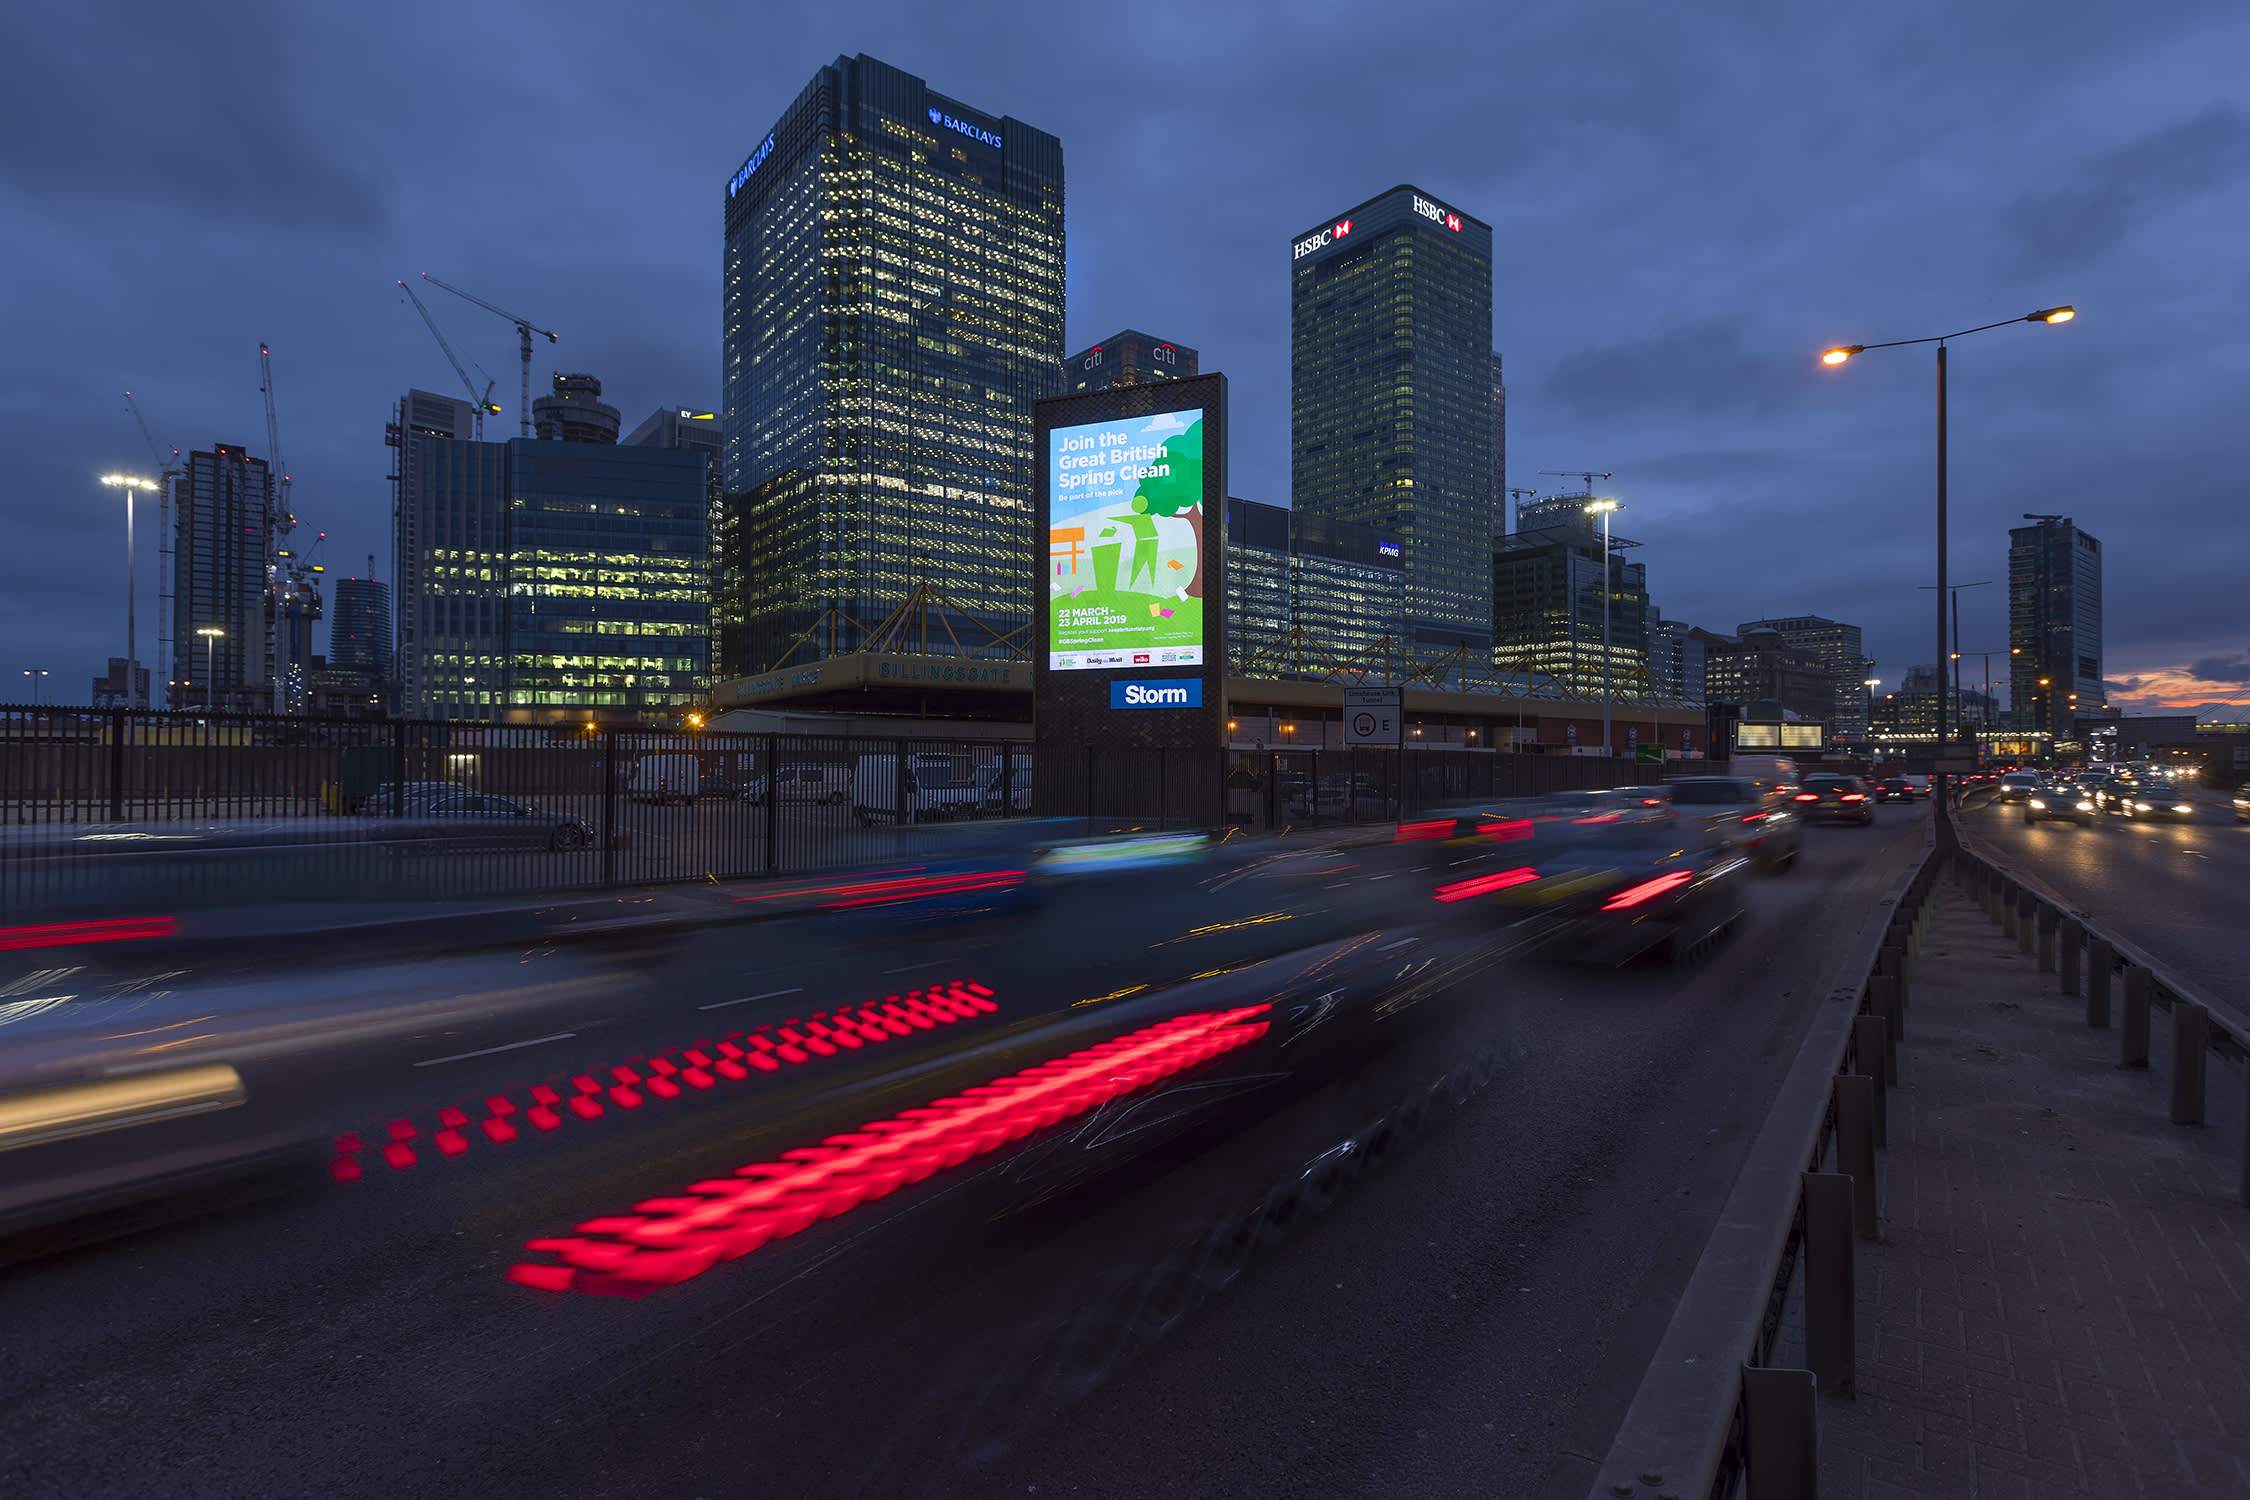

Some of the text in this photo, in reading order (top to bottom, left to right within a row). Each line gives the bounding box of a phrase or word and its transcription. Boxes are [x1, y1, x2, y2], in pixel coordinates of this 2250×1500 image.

[944, 114, 1002, 148] BARCLAYS
[738, 132, 774, 188] BARCLAYS
[1412, 195, 1445, 225] HSBC
[1294, 228, 1332, 260] HSBC
[1084, 350, 1103, 370] citi
[1153, 346, 1176, 366] citi
[680, 410, 692, 419] EY
[1059, 432, 1128, 452] Join the
[1059, 443, 1168, 469] Great British
[1059, 463, 1170, 489] Spring Clean
[1069, 493, 1084, 501] part
[1379, 546, 1399, 557] KPMG
[1058, 609, 1070, 618] 22
[1072, 607, 1109, 617] MARCH
[1058, 615, 1126, 627] 23 APRIL 2019
[880, 662, 1011, 682] BILLINGSGATE
[1125, 685, 1187, 704] Storm
